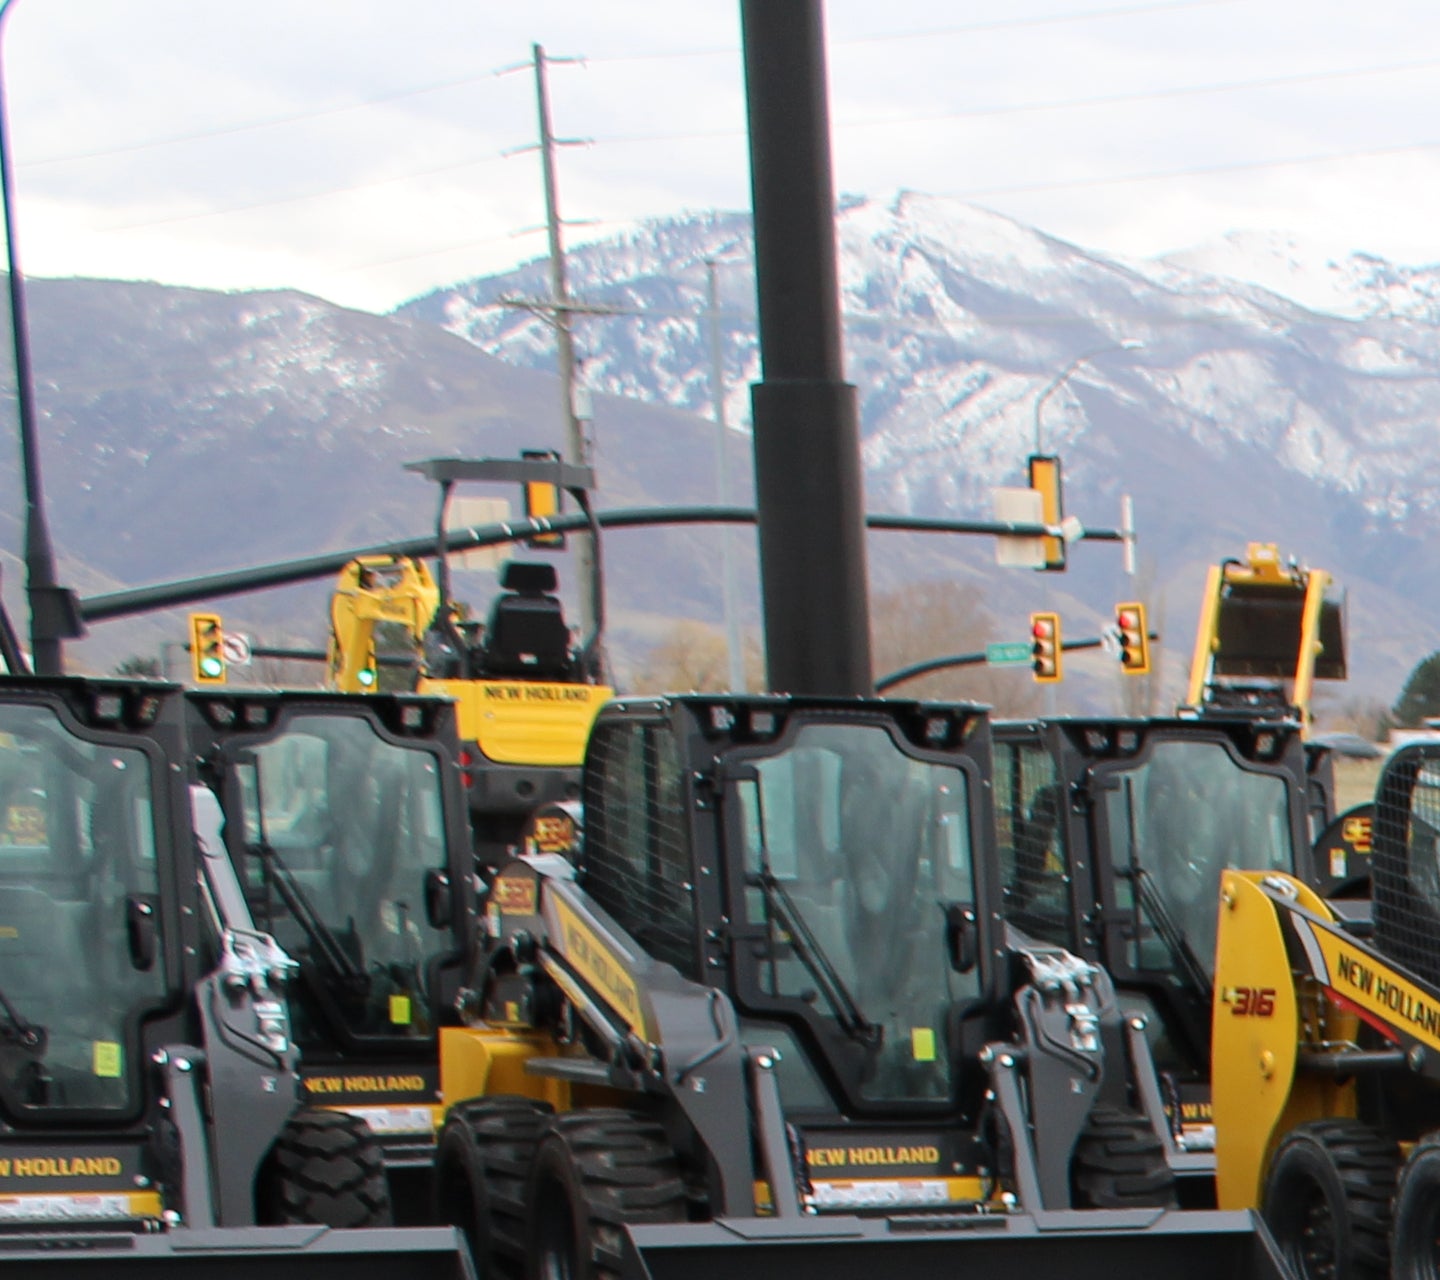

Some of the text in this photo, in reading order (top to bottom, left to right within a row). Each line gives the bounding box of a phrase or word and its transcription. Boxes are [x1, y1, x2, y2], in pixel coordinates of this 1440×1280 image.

[484, 685, 590, 702] NEW HOLLAND
[1337, 951, 1374, 996] NEW
[1222, 986, 1276, 1017] L316
[344, 1075, 425, 1092] HOLLAND
[849, 1146, 941, 1165] HOLLAND
[12, 1156, 123, 1177] HOLLAND
